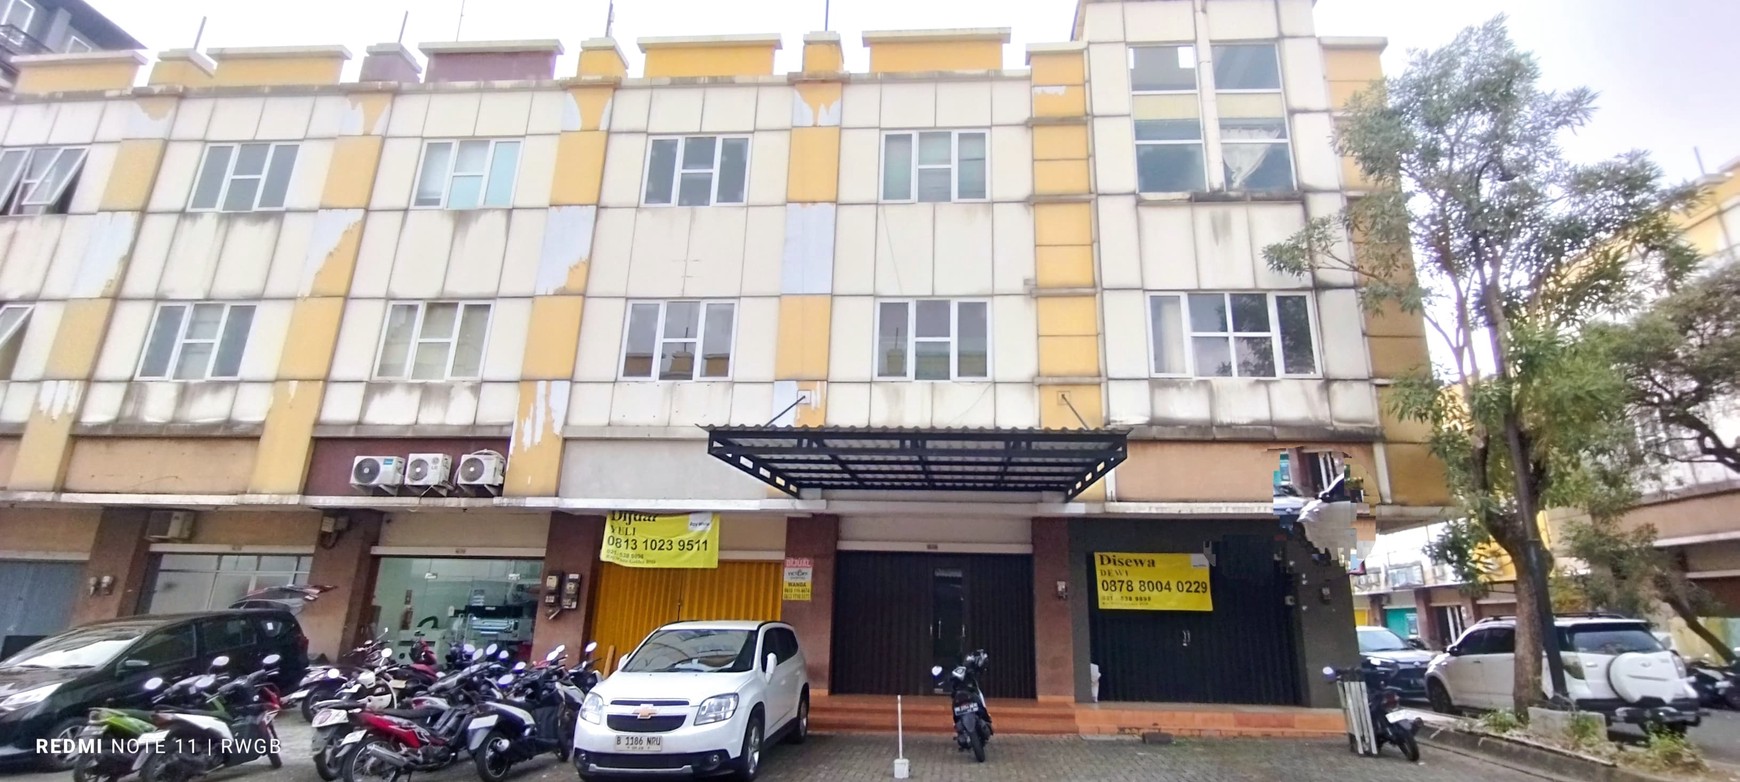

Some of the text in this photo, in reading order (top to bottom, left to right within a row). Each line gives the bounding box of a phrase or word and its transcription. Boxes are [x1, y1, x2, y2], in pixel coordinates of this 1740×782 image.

[611, 525, 636, 536] YULI
[607, 535, 708, 551] 0813 1023 9511
[1099, 554, 1156, 567] Disewa
[1100, 569, 1129, 577] DEWI
[1101, 579, 1208, 593] 0878 8004 0229
[616, 736, 621, 745] B
[625, 736, 644, 746] 1186
